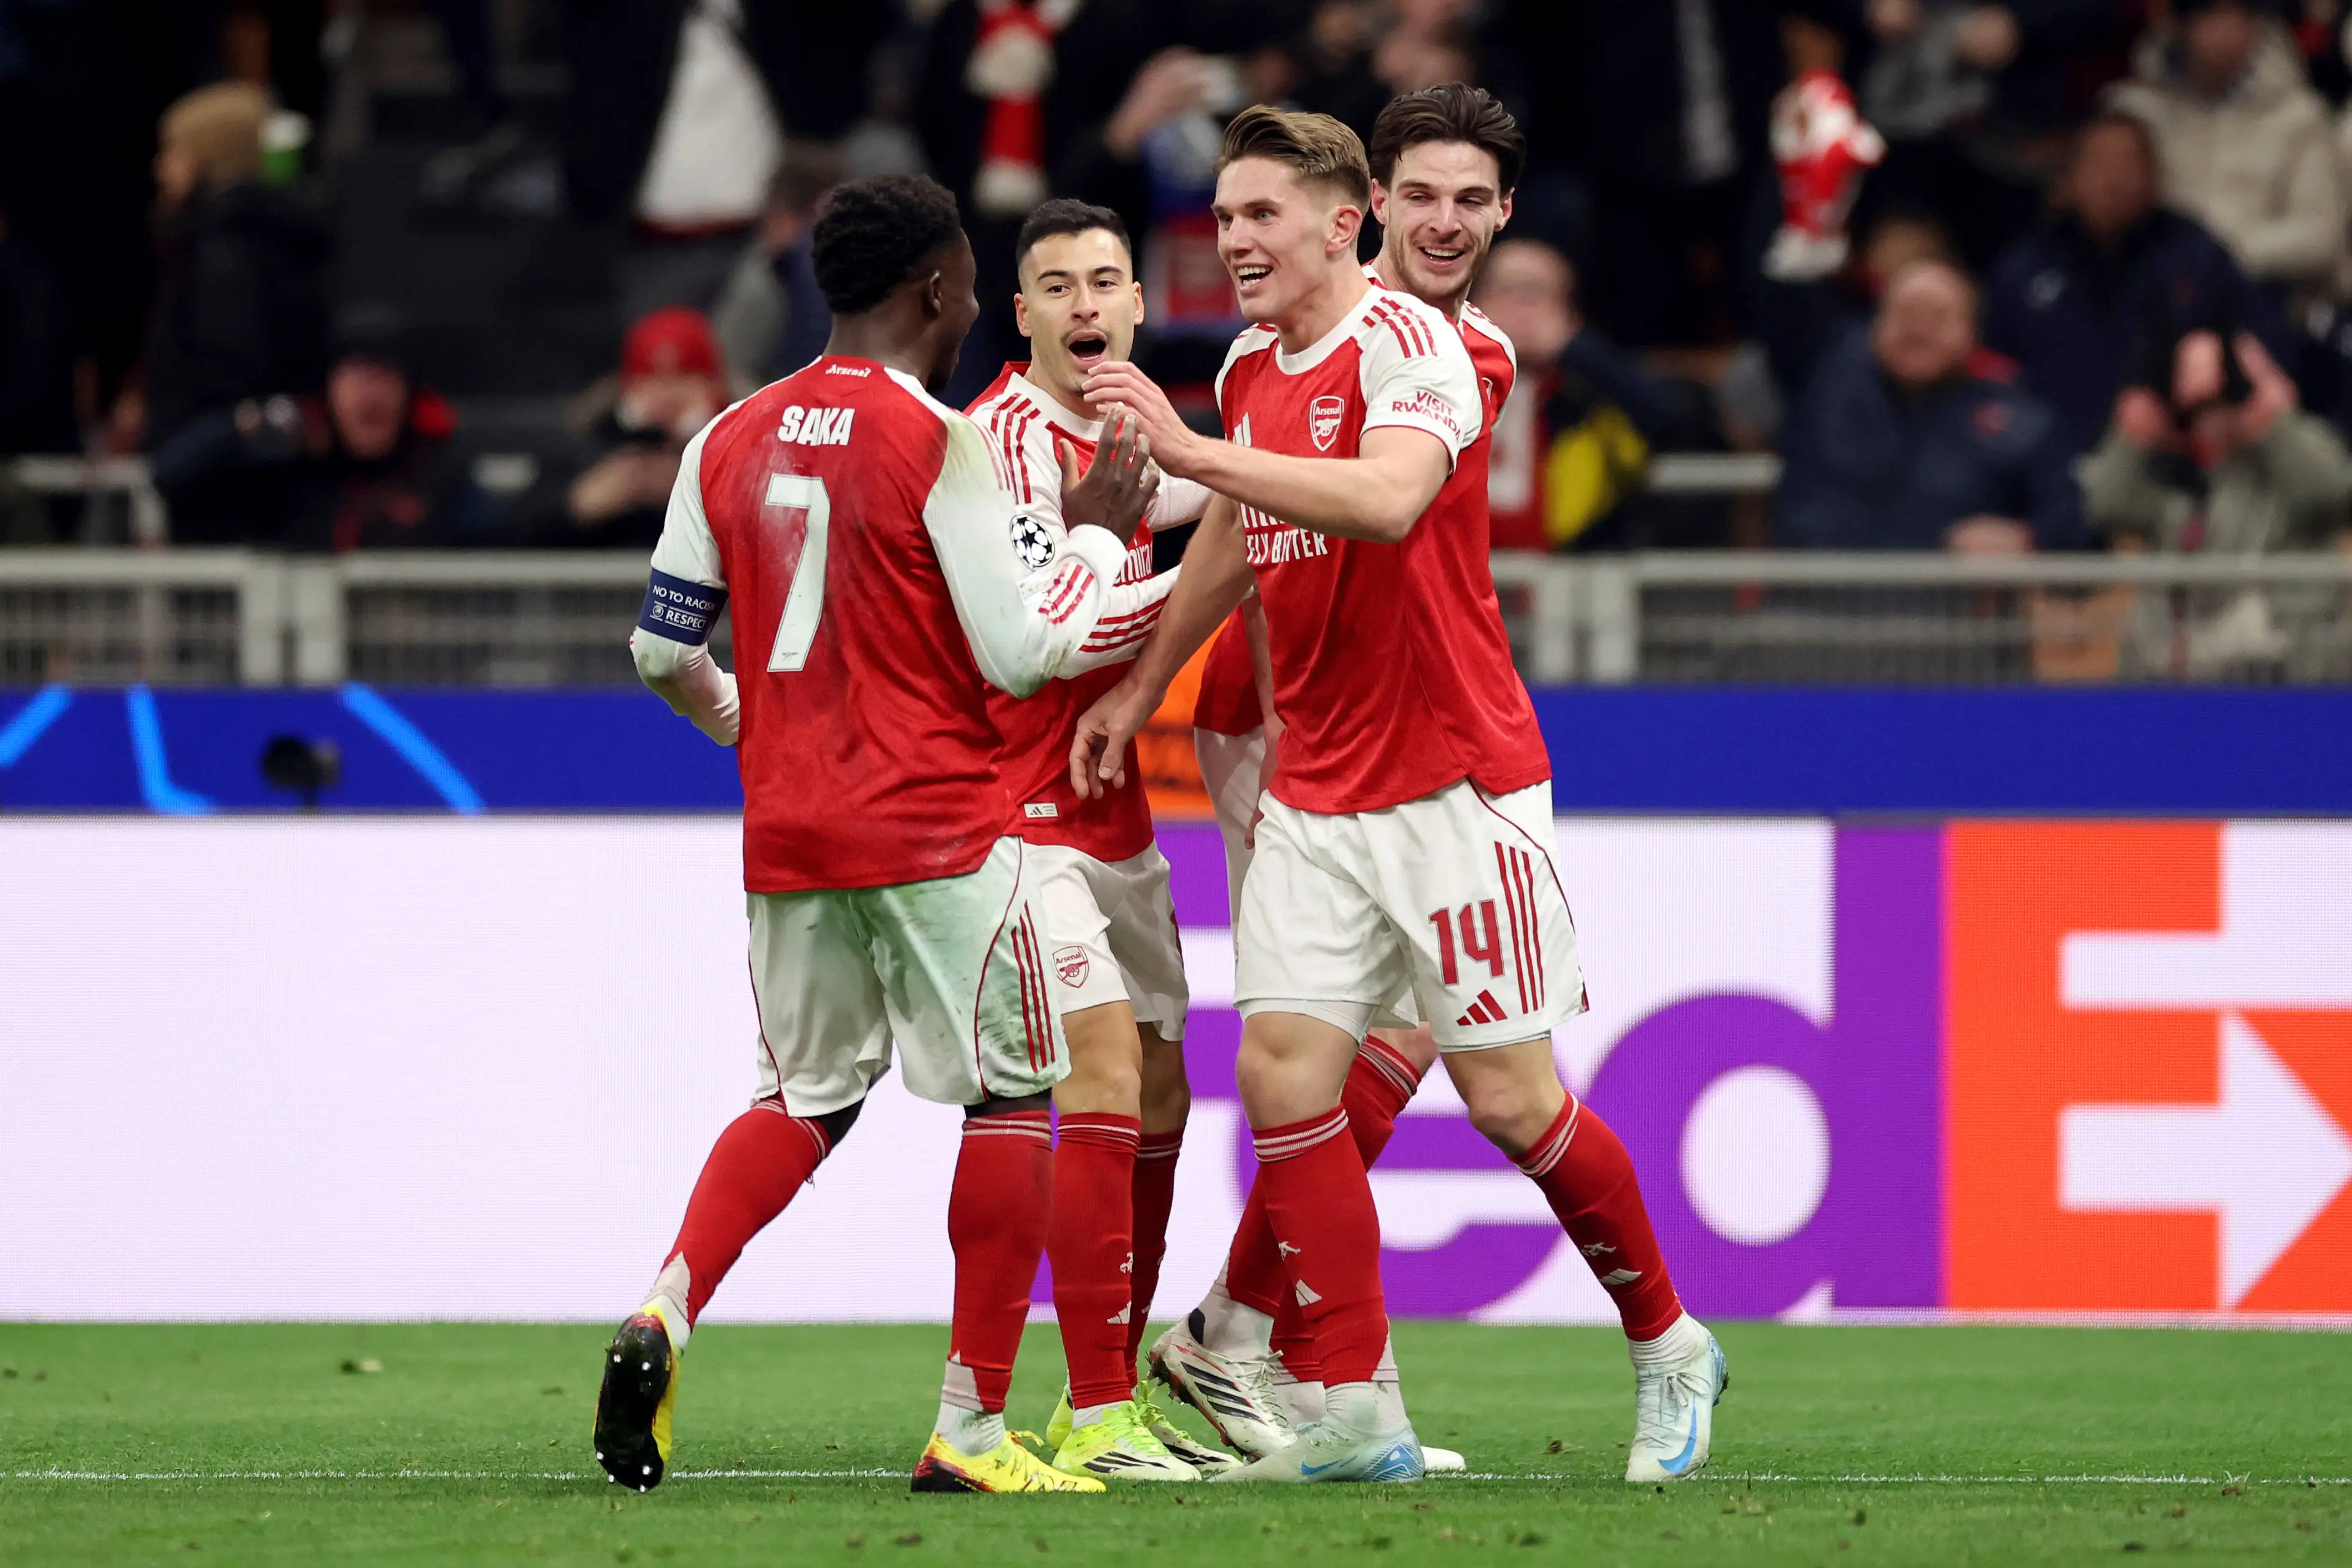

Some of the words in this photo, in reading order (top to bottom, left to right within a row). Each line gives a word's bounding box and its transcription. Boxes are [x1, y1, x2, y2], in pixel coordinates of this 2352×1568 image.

[826, 364, 872, 378] Arsenal
[1315, 406, 1341, 416] Arsenal
[1417, 391, 1453, 416] VISIT
[777, 405, 856, 446] SAKA
[765, 473, 830, 672] 7
[652, 585, 667, 598] NO
[669, 590, 684, 603] TO
[684, 595, 715, 611] RACIS
[1428, 898, 1506, 987] 14
[1056, 951, 1082, 965] Arsenal
